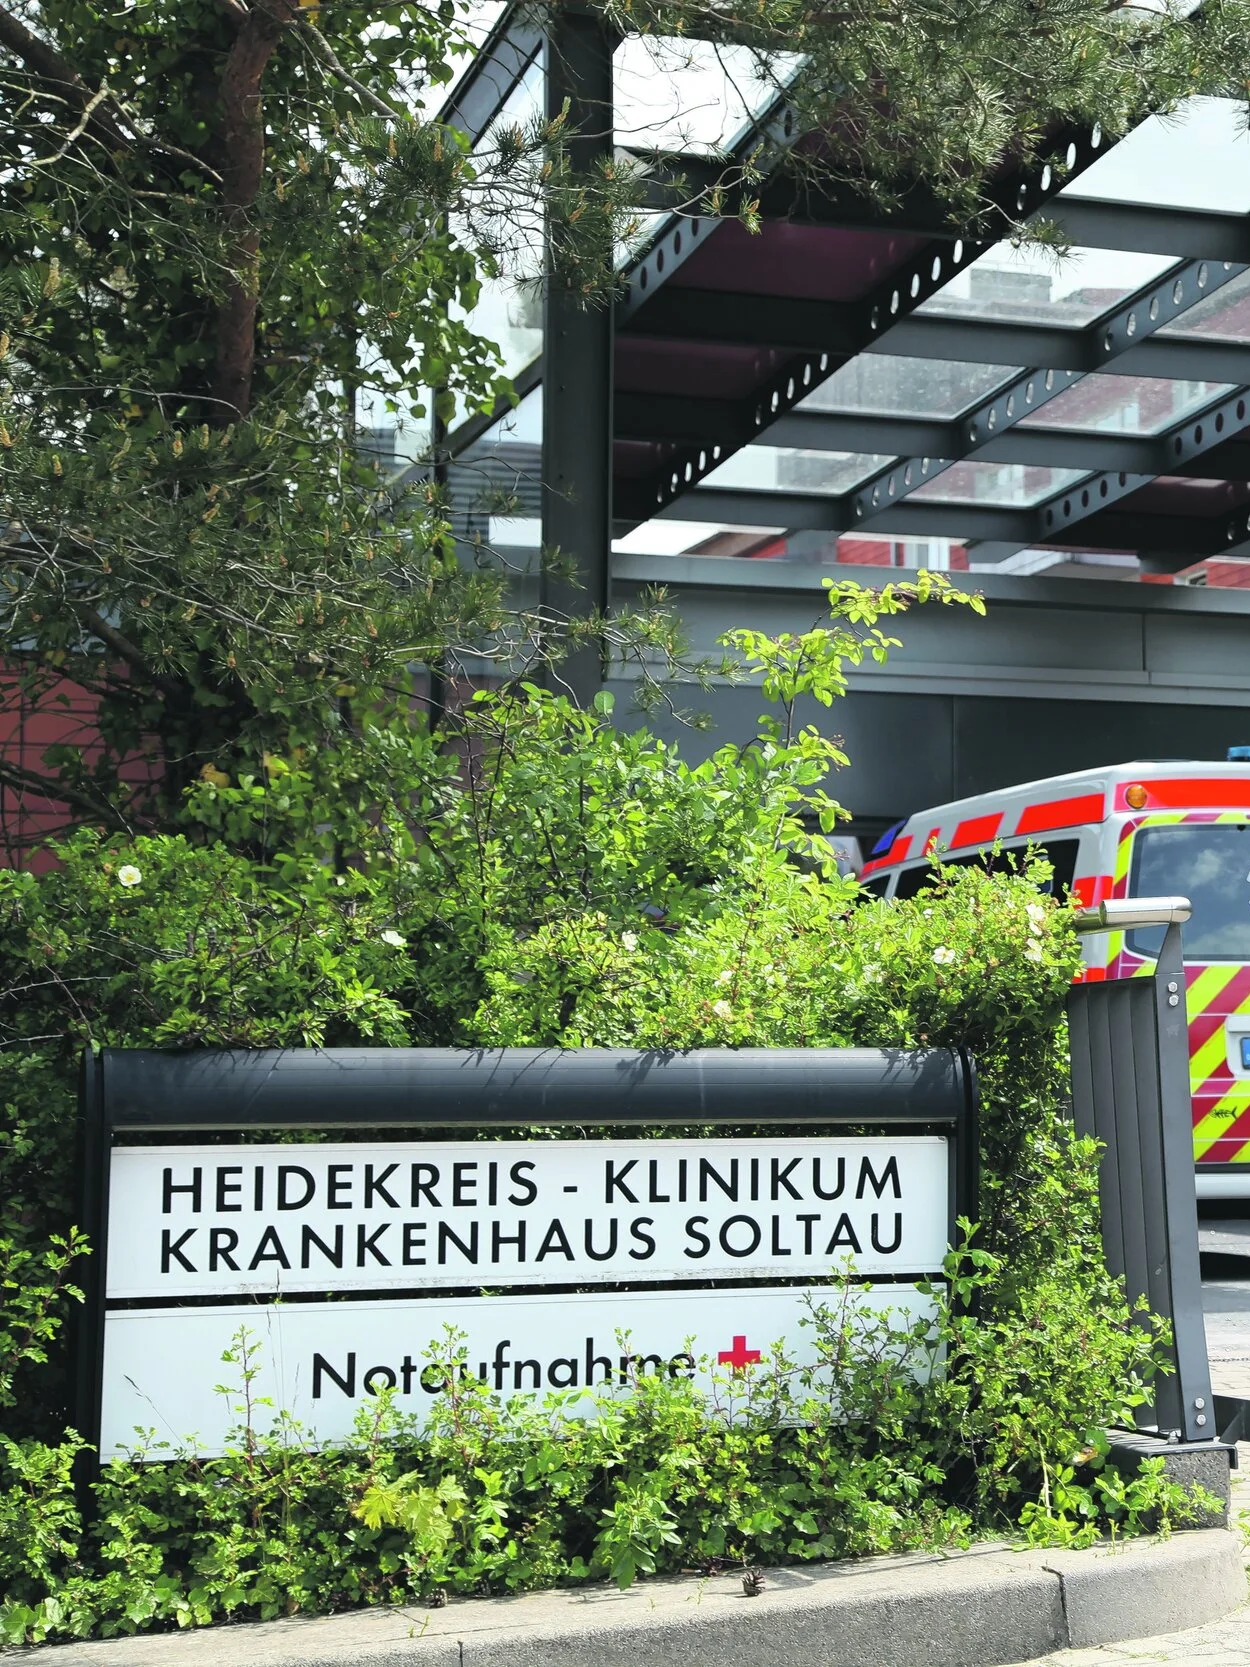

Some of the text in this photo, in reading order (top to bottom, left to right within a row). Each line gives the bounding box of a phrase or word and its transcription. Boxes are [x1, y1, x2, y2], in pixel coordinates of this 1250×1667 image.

[161, 1161, 538, 1213] HEIDEKREIS
[604, 1156, 902, 1203] KLINIKUM
[161, 1212, 902, 1273] KRANKENHAUS SOLTAU
